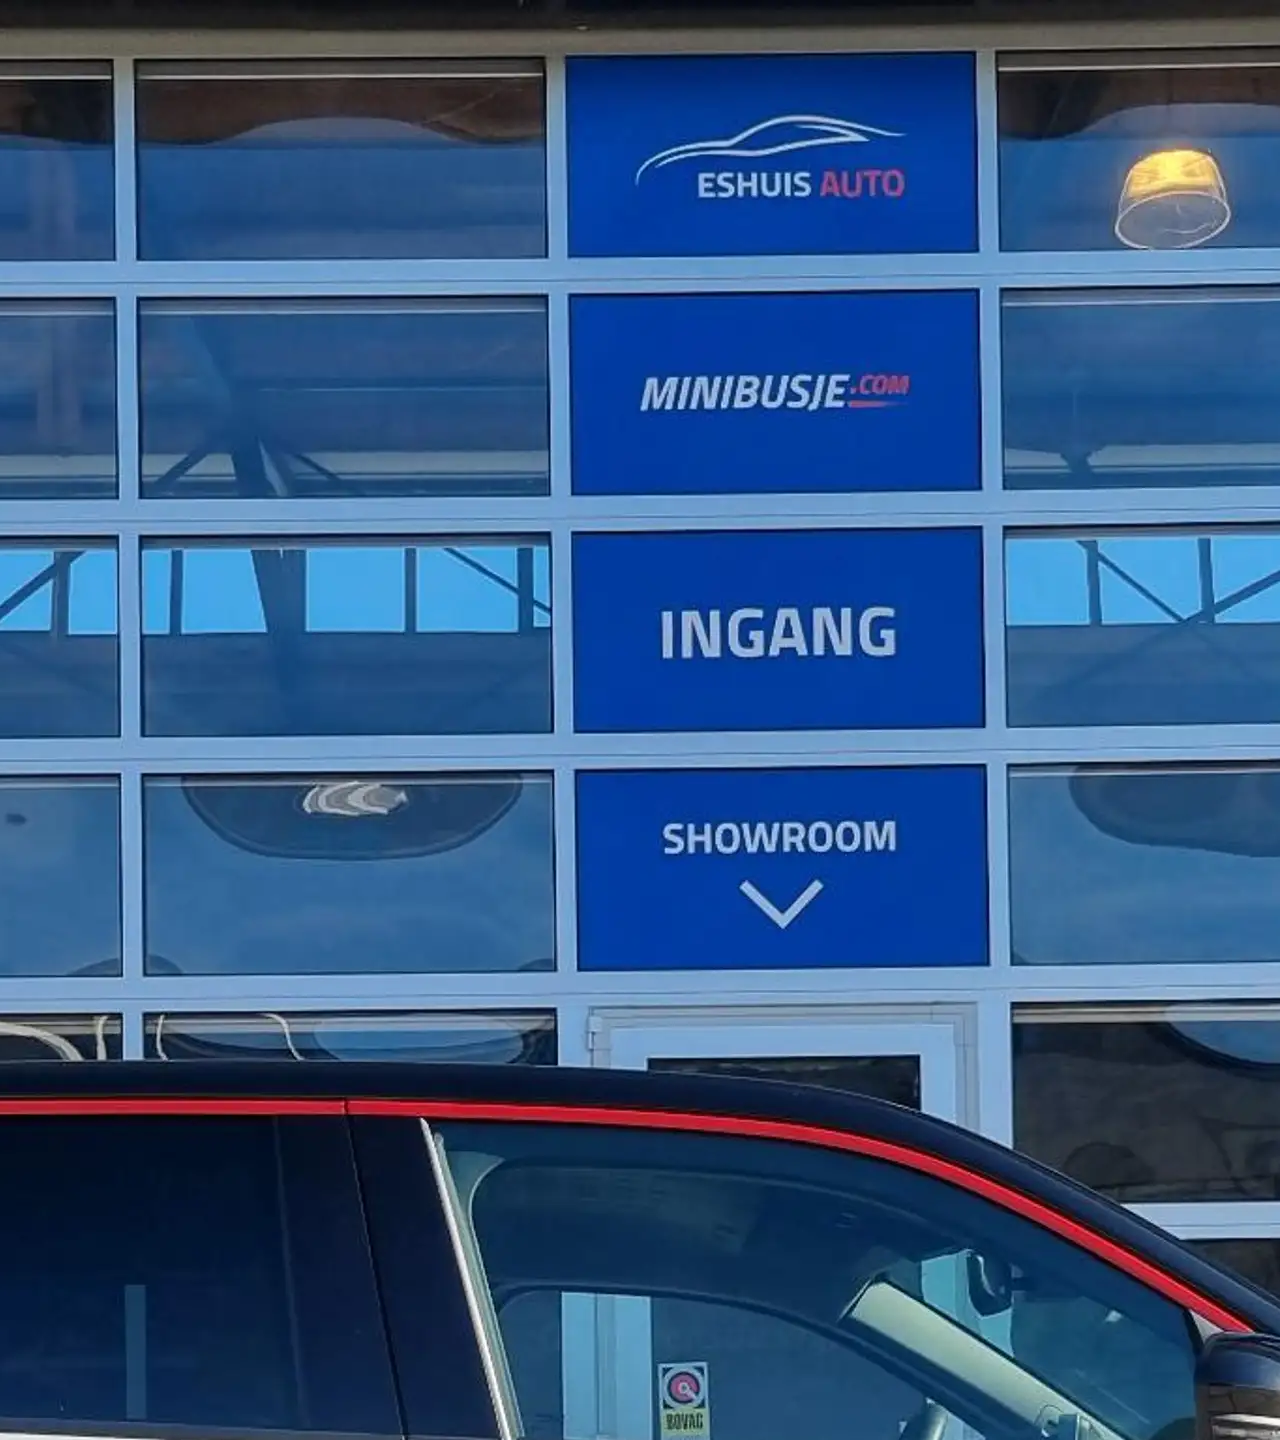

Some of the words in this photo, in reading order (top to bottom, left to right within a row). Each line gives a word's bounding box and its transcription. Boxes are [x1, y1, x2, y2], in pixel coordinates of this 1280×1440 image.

[697, 171, 812, 199] ESHUIS
[820, 169, 906, 198] AUTO
[640, 373, 910, 412] MINIBUSJE.COM
[661, 607, 897, 659] INGANG
[662, 820, 897, 855] SHOWROOM
